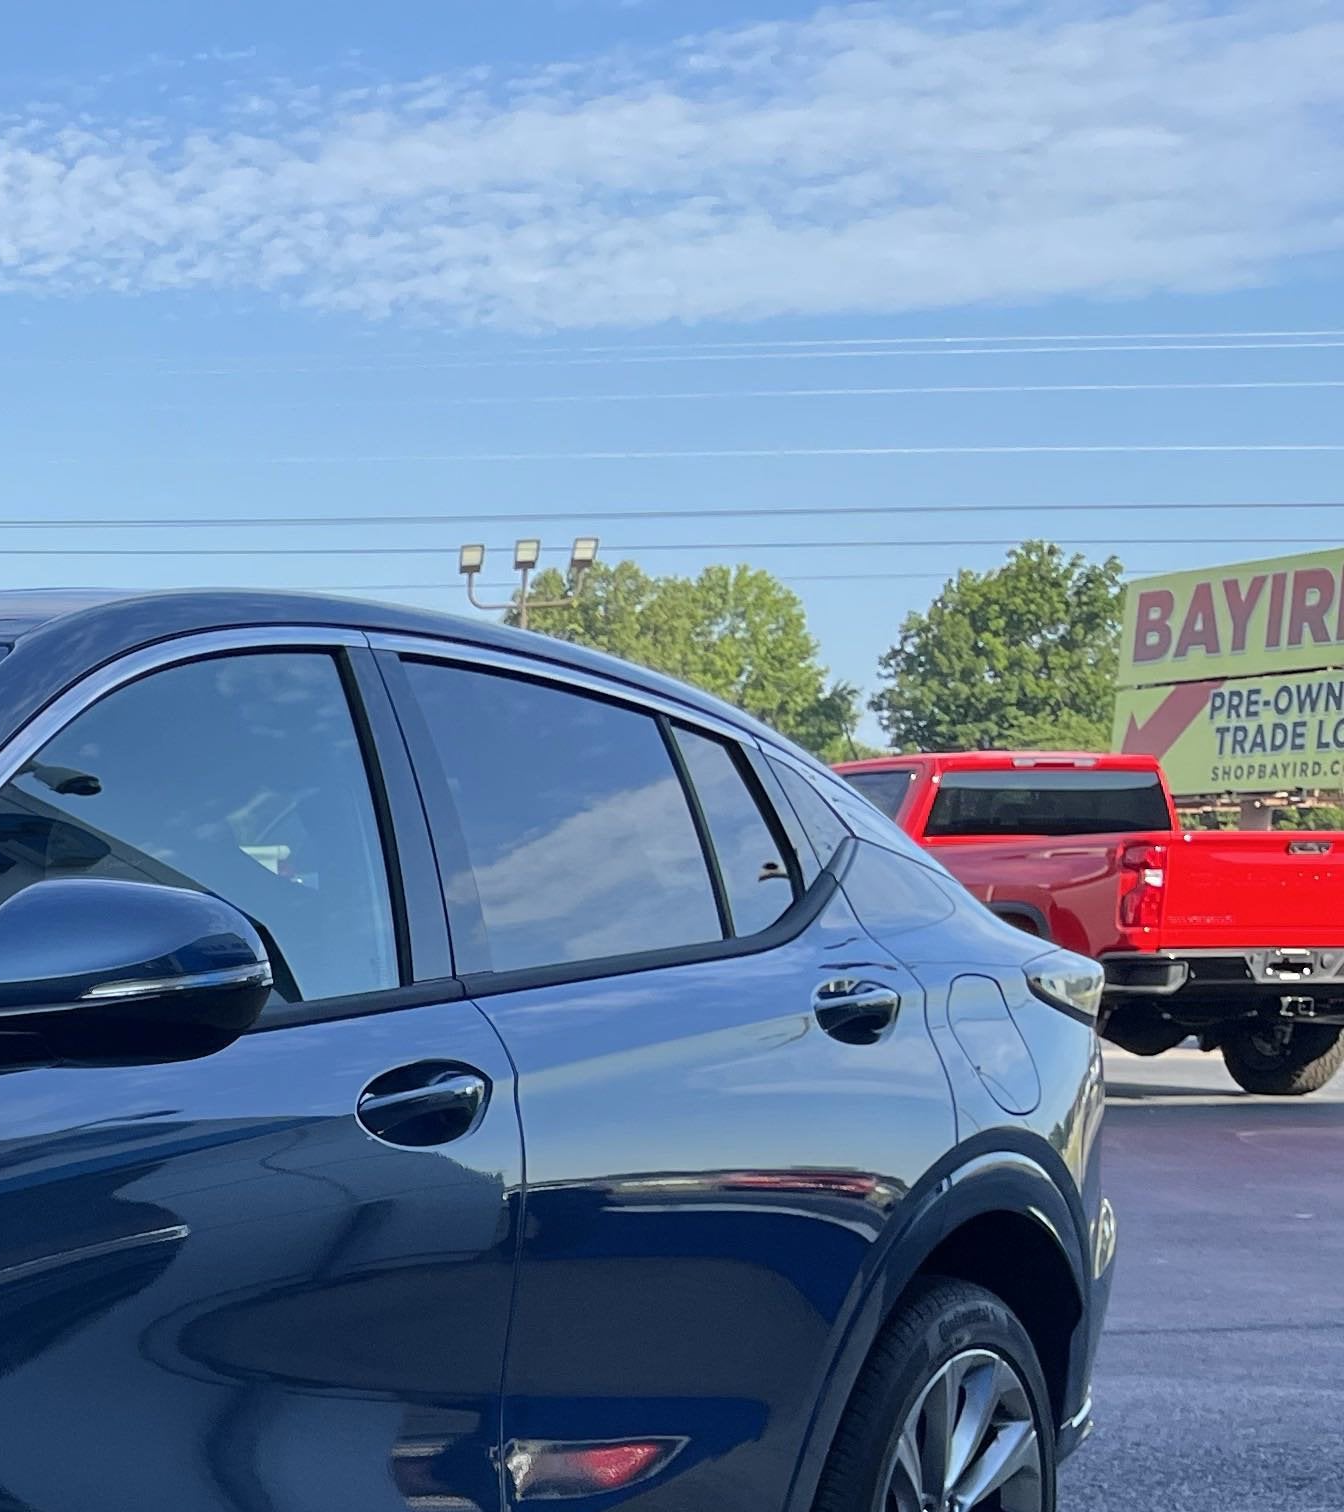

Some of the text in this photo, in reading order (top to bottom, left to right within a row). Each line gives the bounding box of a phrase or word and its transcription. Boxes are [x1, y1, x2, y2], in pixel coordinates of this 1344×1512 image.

[1132, 564, 1344, 663] BAYIR
[1215, 720, 1307, 755] TRADE
[1211, 760, 1344, 781] SHOPBAYIRD.C
